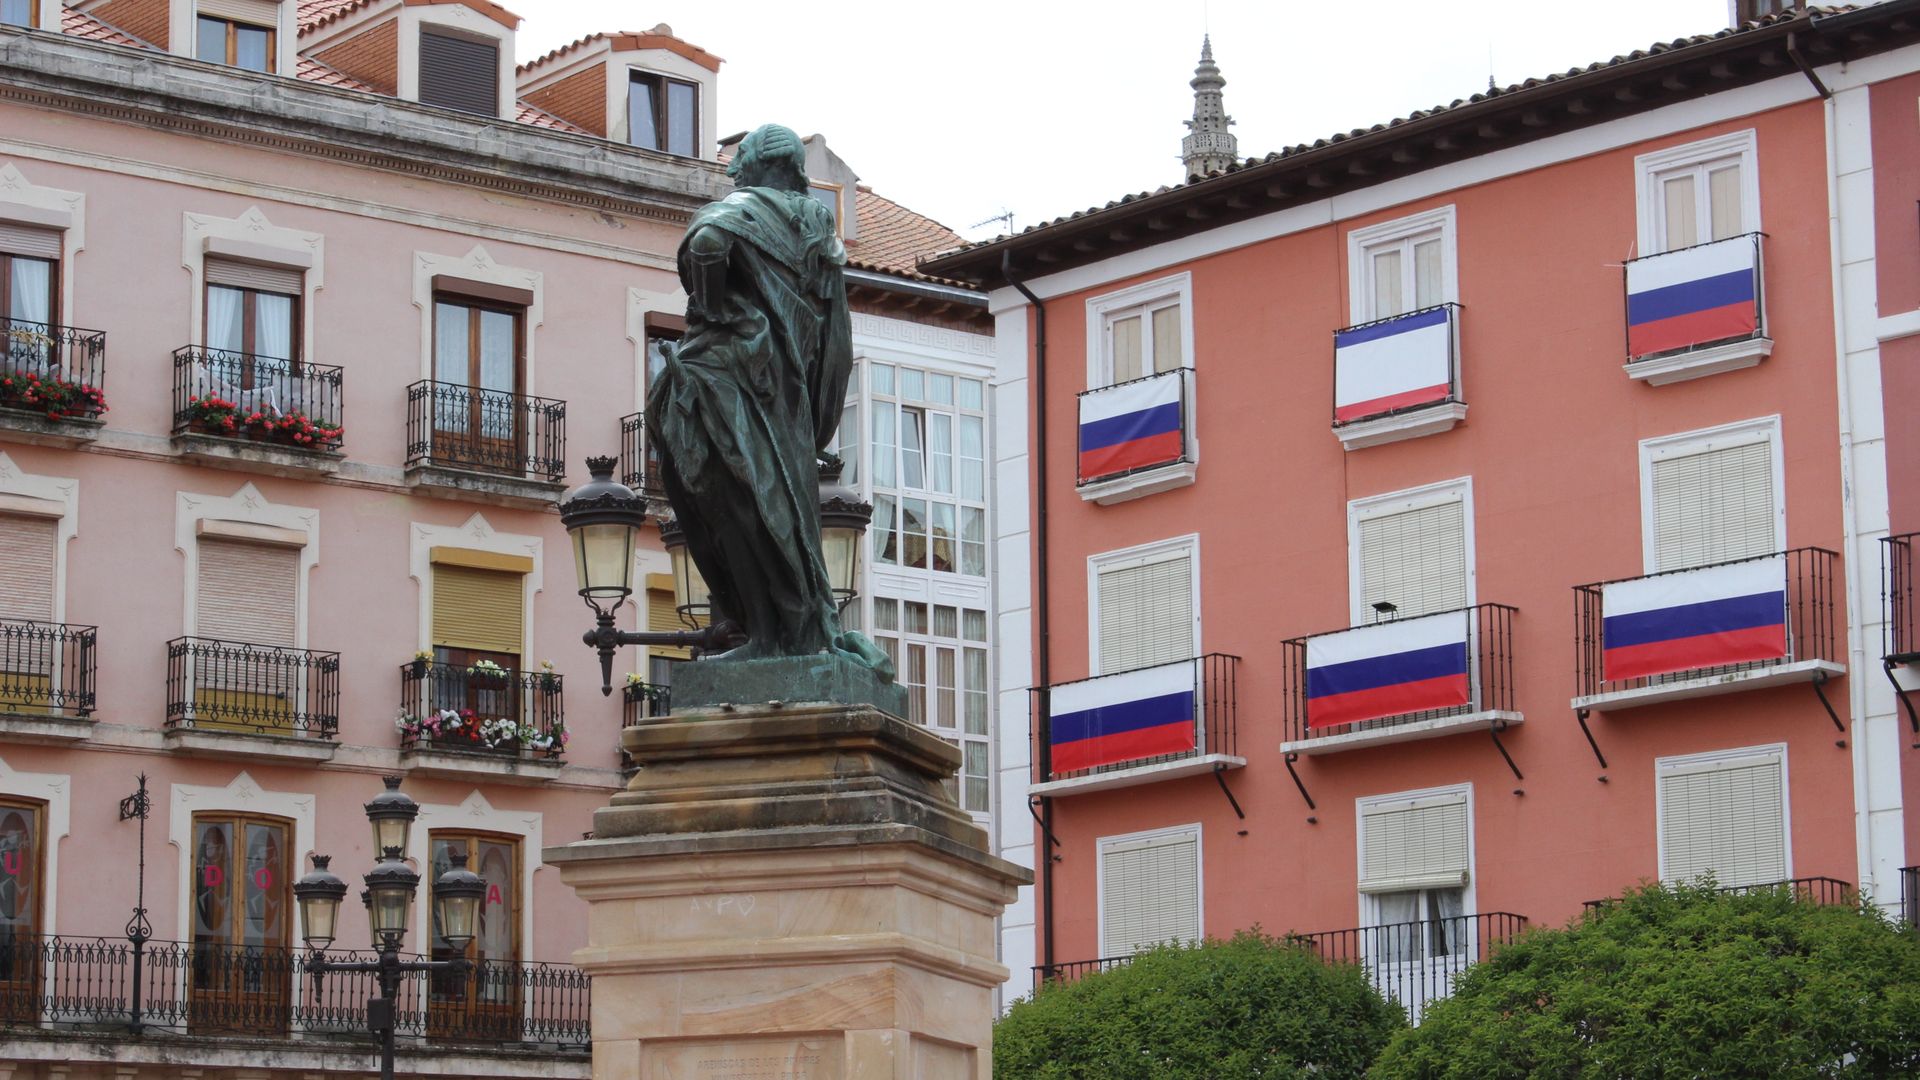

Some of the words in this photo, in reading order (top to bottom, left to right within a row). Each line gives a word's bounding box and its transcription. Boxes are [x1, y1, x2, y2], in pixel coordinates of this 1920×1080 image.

[204, 864, 224, 887] D
[255, 867, 272, 891] O
[487, 883, 503, 905] A
